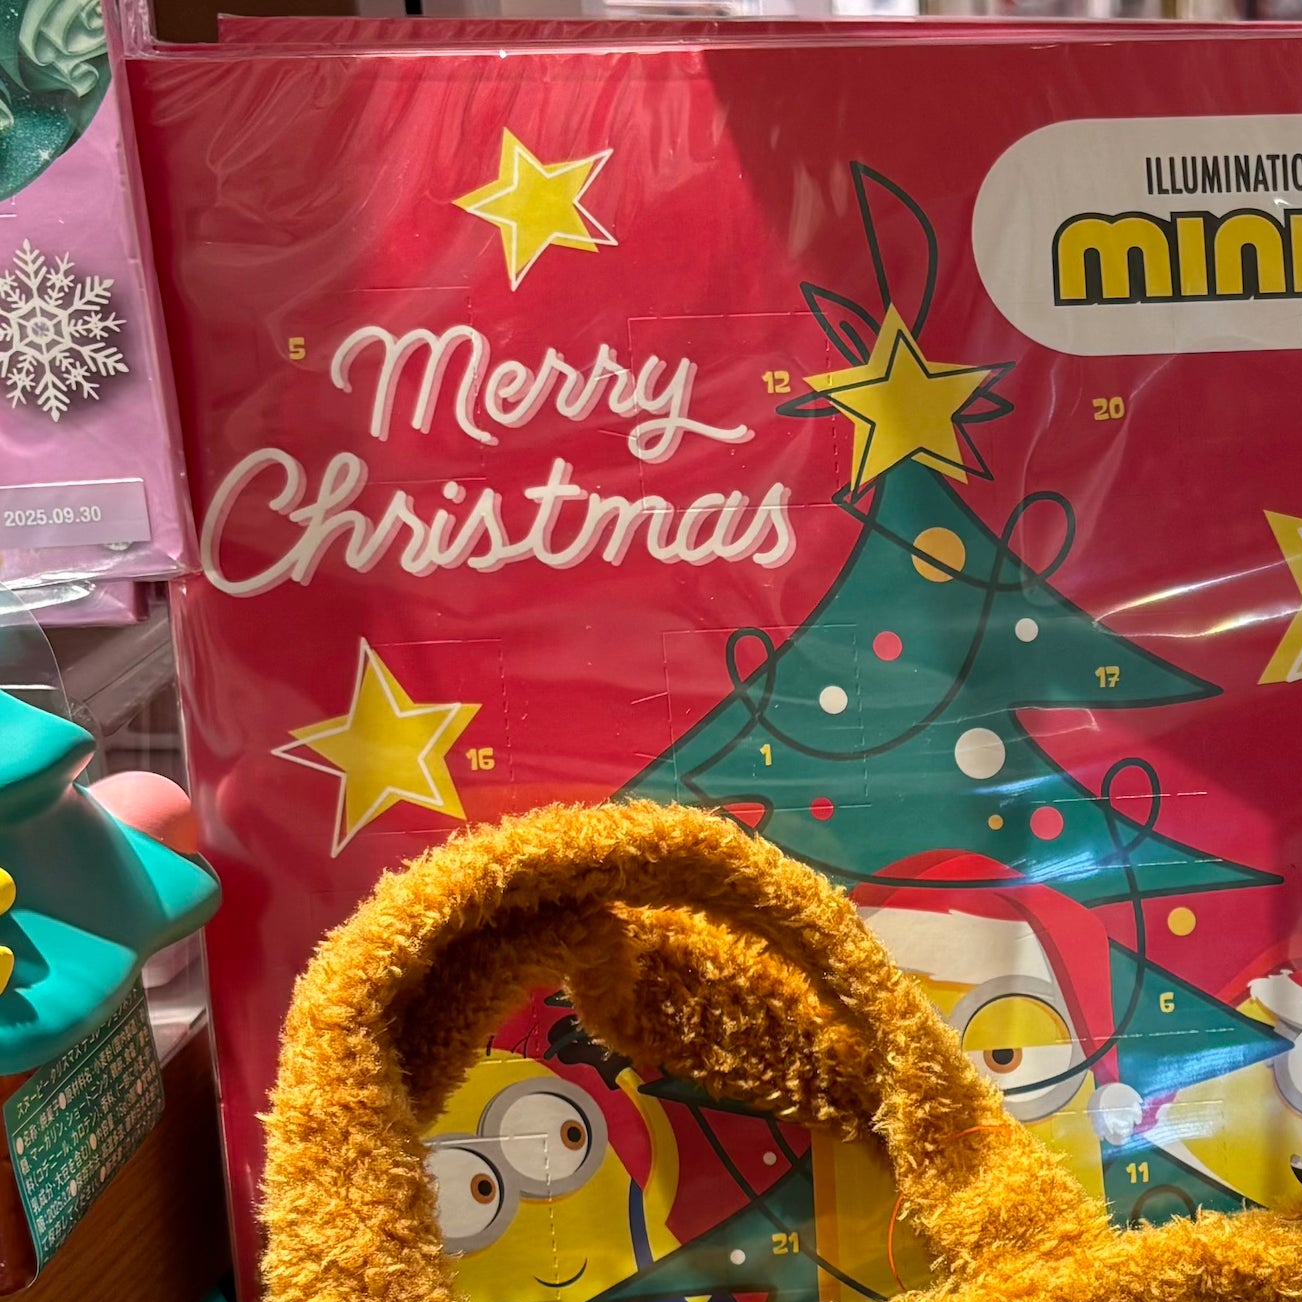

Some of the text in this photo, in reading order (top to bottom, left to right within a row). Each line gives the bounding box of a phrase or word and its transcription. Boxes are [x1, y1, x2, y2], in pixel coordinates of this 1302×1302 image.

[288, 337, 306, 359] 5
[330, 324, 755, 463] Merry
[762, 370, 792, 394] 12
[1092, 396, 1126, 420] 20
[4, 505, 102, 527] 2025.09.30
[201, 447, 797, 598] Christmas
[1094, 665, 1121, 688] 17
[465, 747, 496, 771] 16
[759, 743, 773, 767] 1
[1159, 991, 1176, 1013] 6
[1126, 1161, 1150, 1184] 11
[771, 1231, 800, 1255] 21
